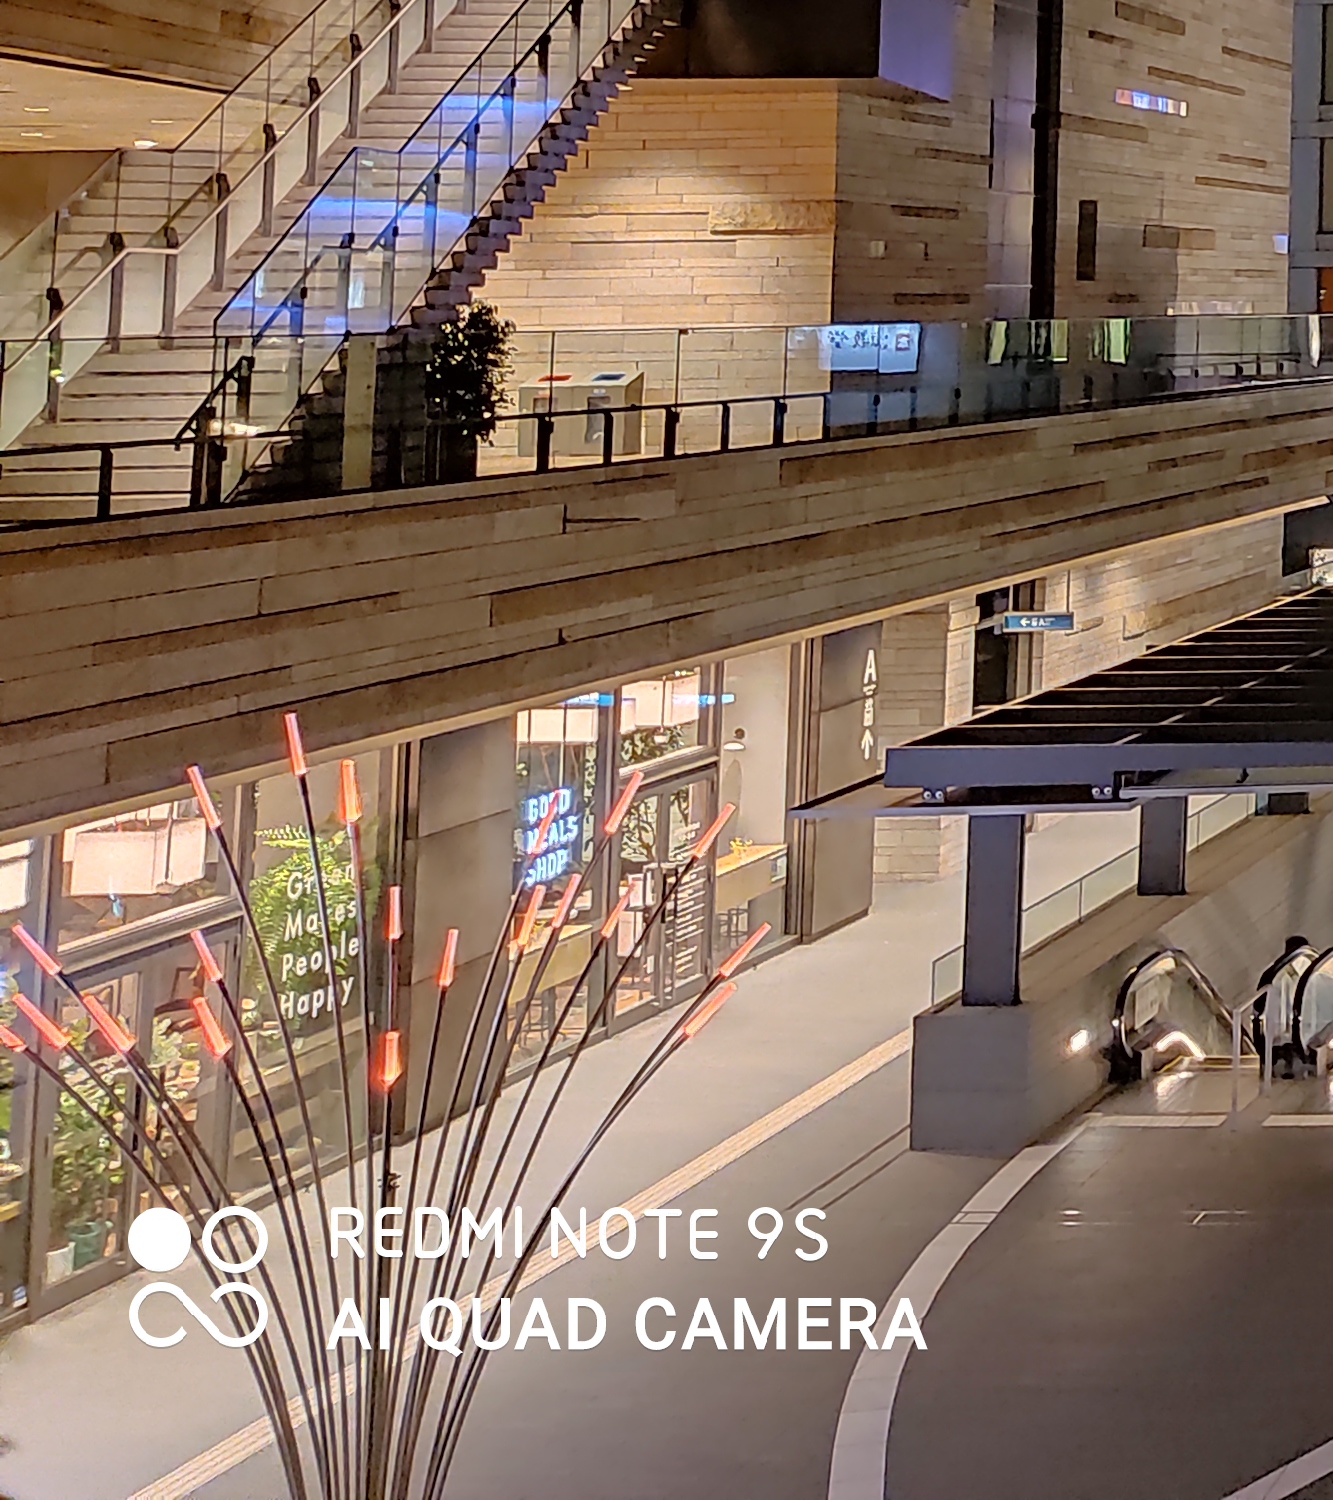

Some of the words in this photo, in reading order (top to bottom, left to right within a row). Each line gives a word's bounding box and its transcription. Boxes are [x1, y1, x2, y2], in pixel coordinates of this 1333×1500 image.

[863, 649, 877, 684] A
[525, 848, 569, 887] SHOP
[284, 900, 358, 942] Maes
